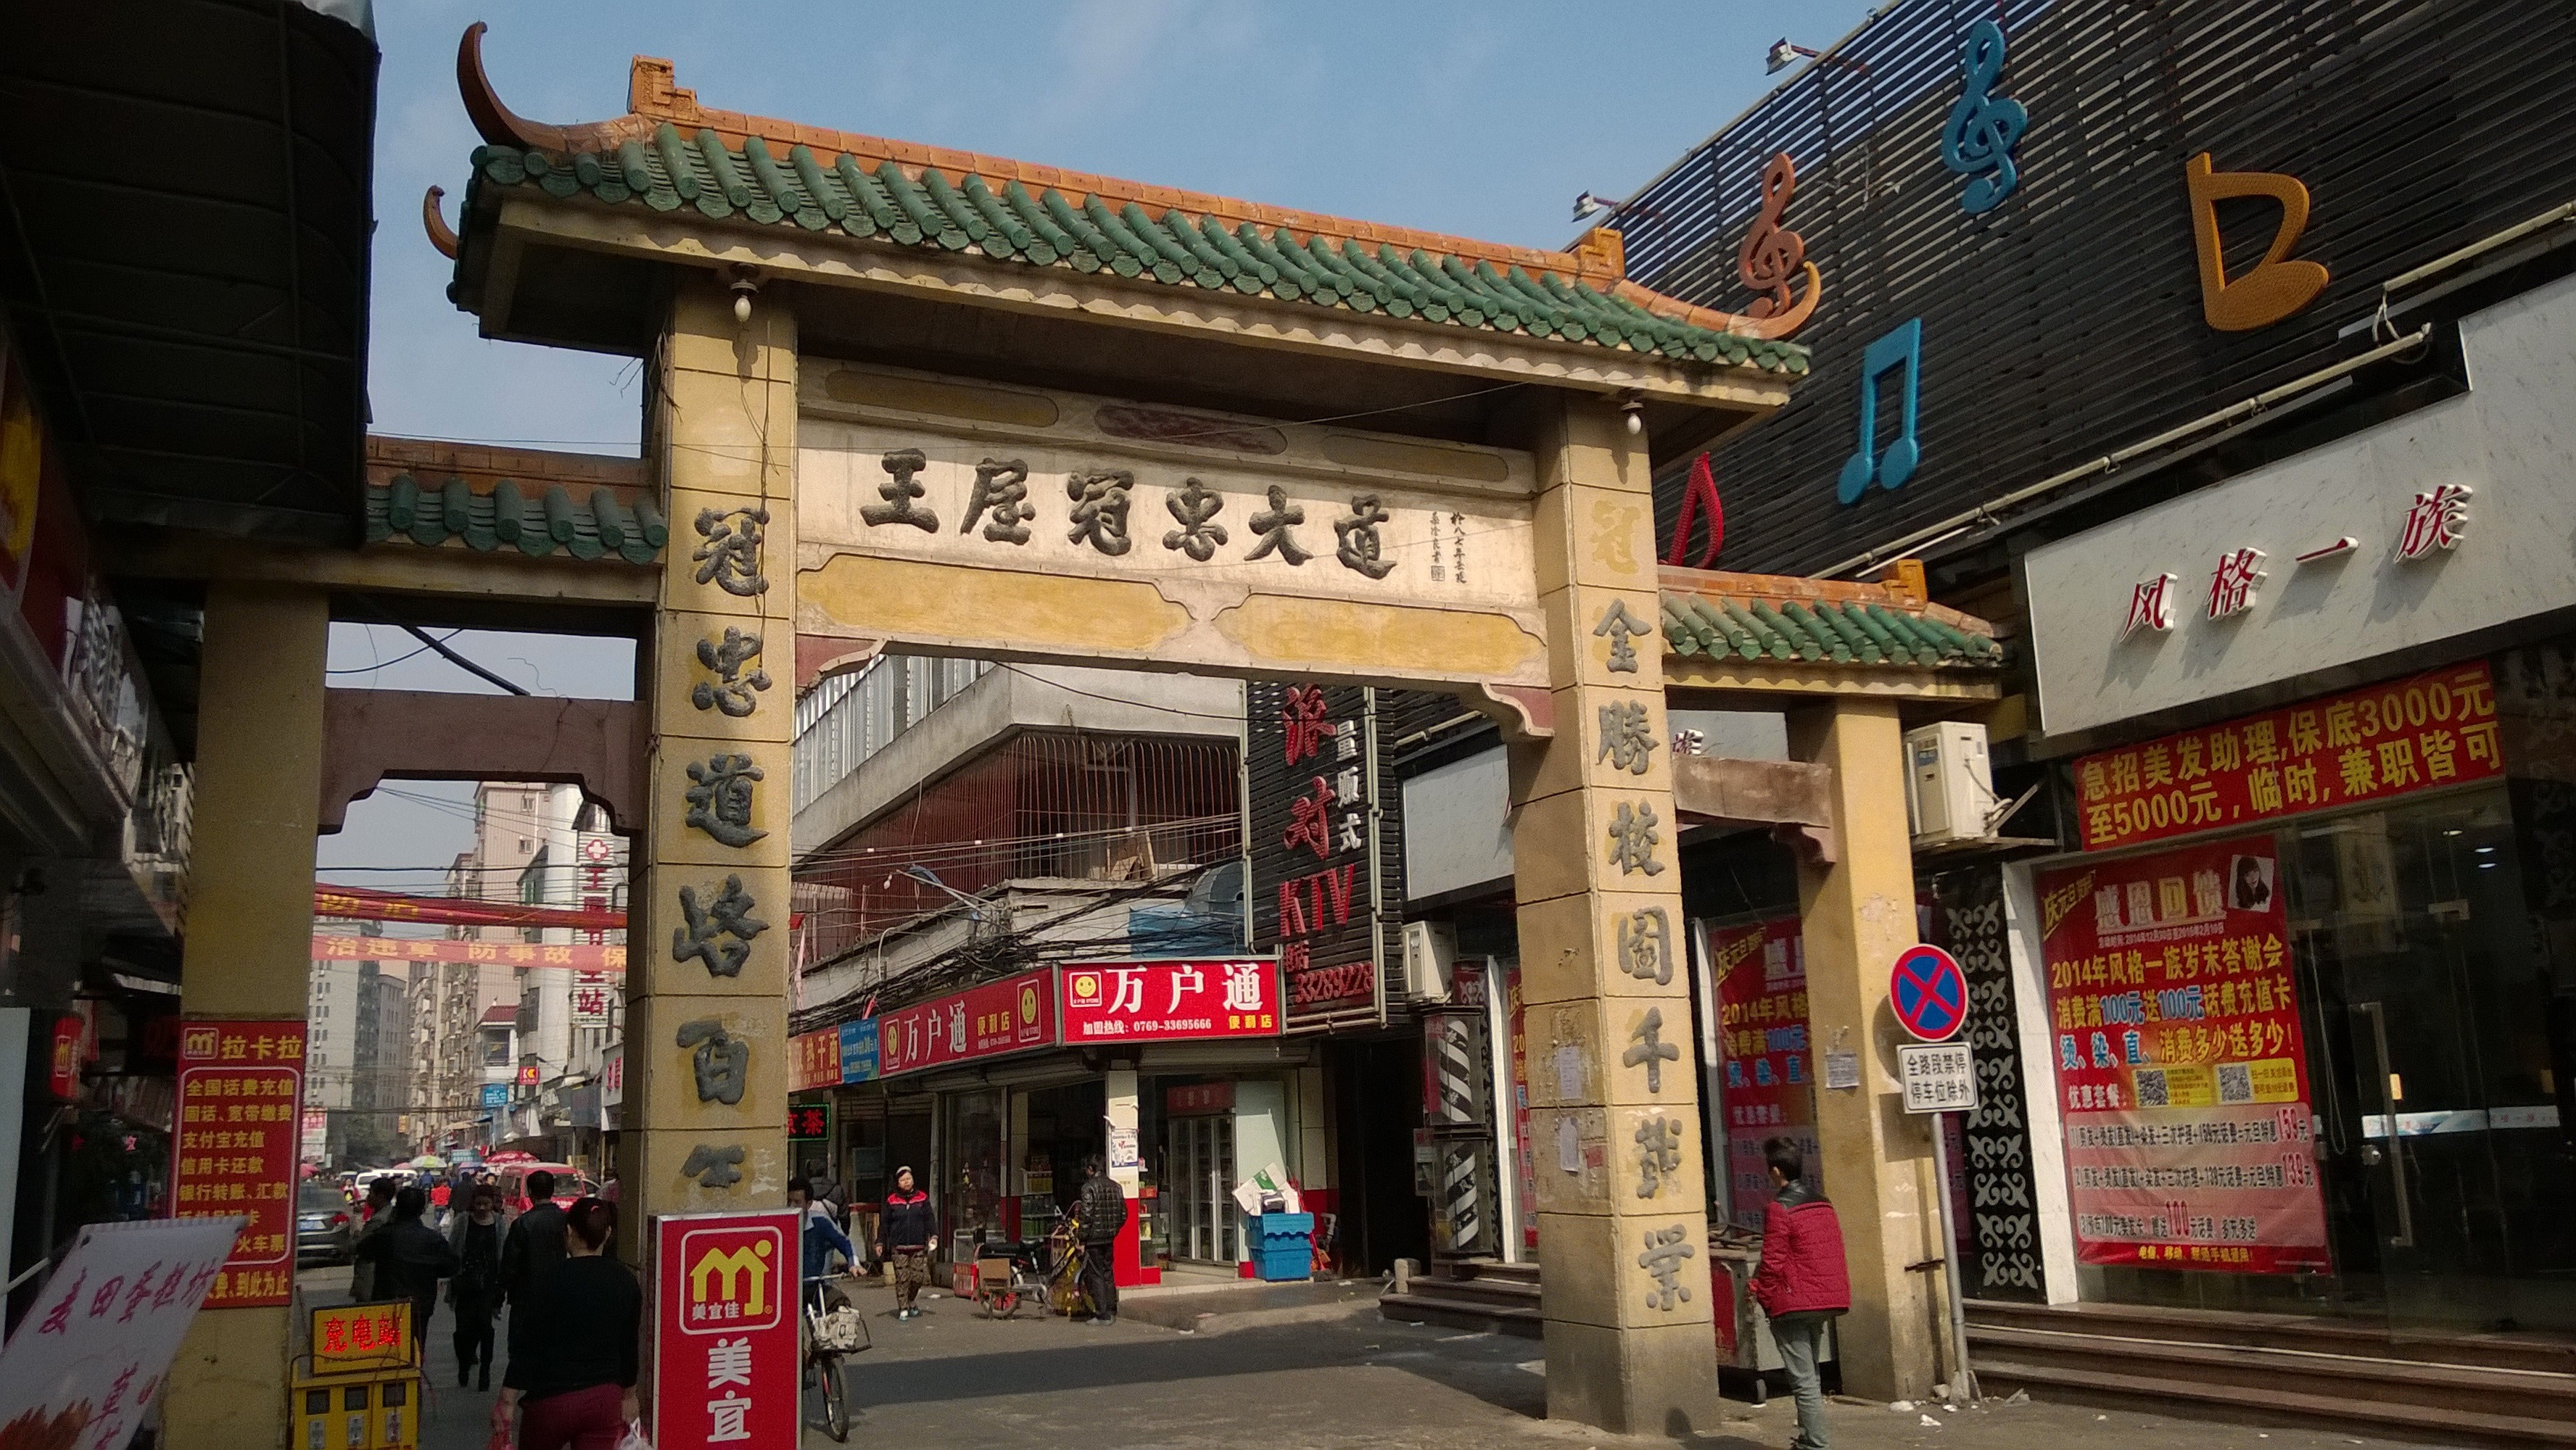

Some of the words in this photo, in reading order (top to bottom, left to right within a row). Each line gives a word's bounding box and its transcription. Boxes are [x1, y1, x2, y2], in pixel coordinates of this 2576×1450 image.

[860, 447, 1398, 580] 王屋冠忠大道
[2119, 483, 2473, 642] 风格一族
[1280, 864, 1355, 937] KTV
[2052, 932, 2283, 990] 2014年风格一族岁末答谢会
[1105, 962, 1263, 1014] 万户通
[2055, 974, 2292, 1030] 消费满100元送100元话费充值卡
[221, 1035, 302, 1060] 拉卡拉
[904, 999, 968, 1063] 万户通
[1907, 1052, 1968, 1077] 全路段禁停
[186, 1078, 294, 1097] 全国话费充值
[1910, 1079, 1971, 1104] 停车位除外
[182, 1130, 265, 1149] 支付宝充值
[180, 1156, 264, 1175] 信用卡还款
[178, 1181, 289, 1201] 银行转账、汇款
[691, 1302, 740, 1321] 美宜佳
[323, 1312, 402, 1354] 充电站
[706, 1336, 752, 1443] 美宜
